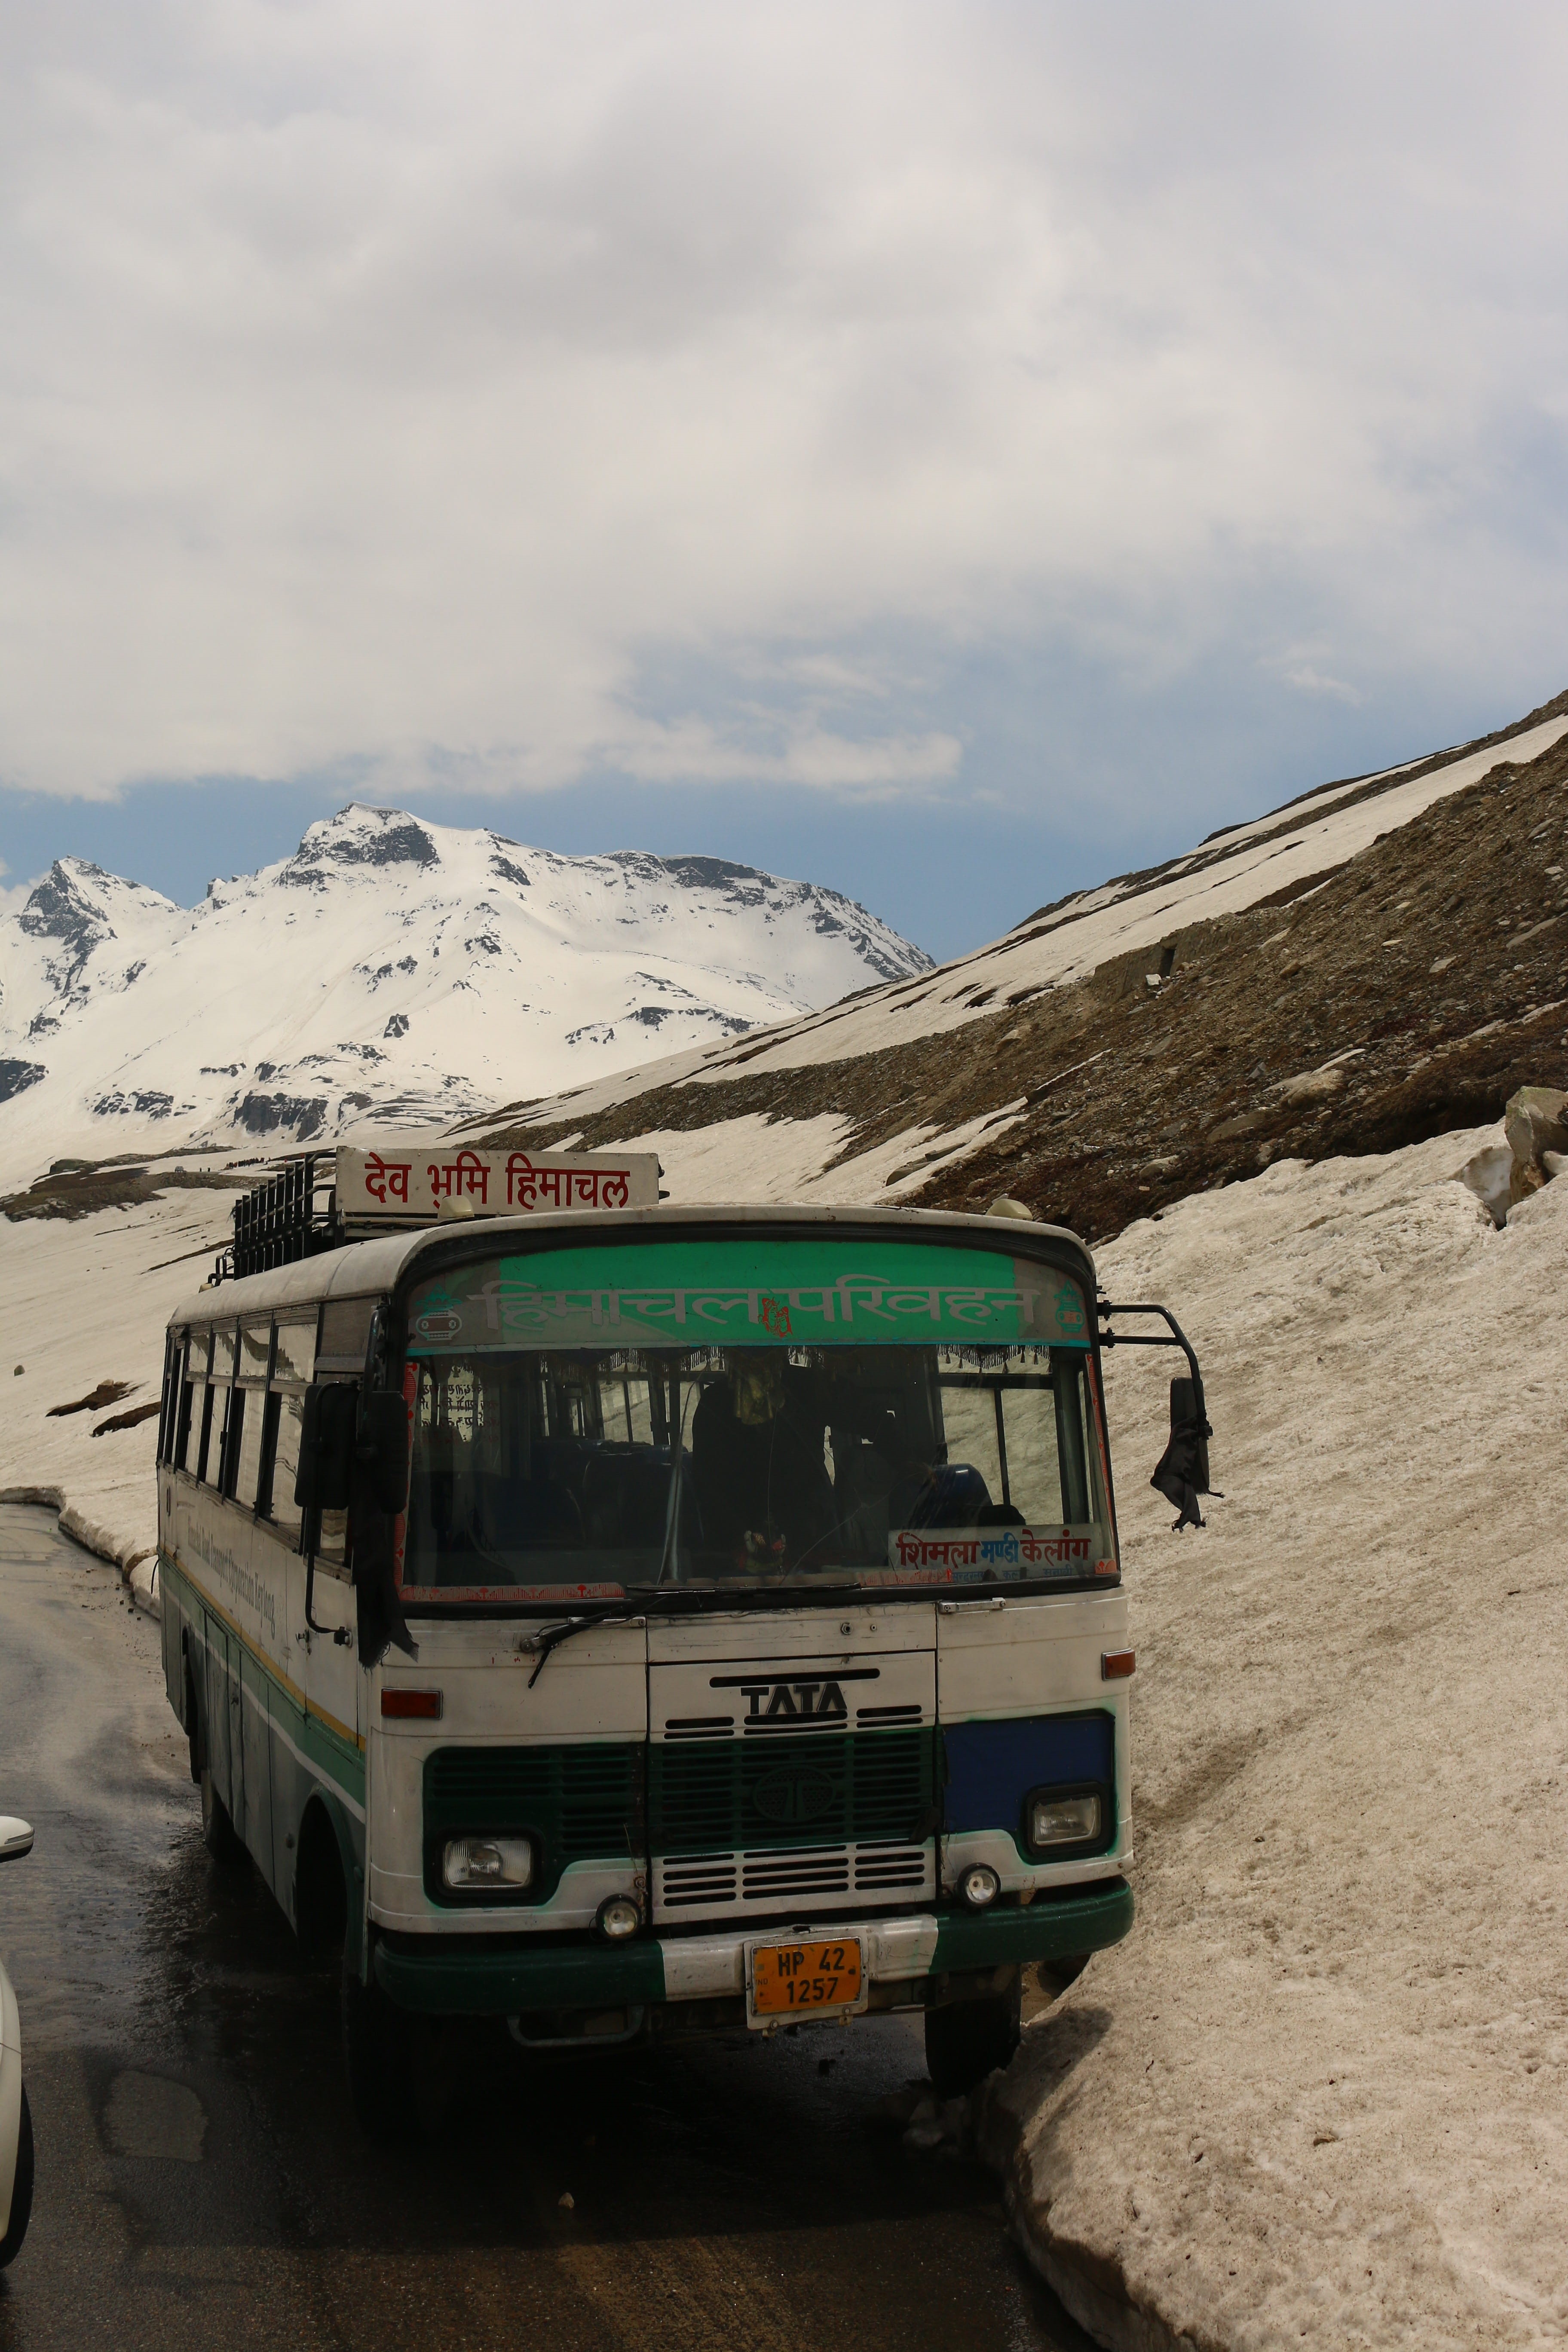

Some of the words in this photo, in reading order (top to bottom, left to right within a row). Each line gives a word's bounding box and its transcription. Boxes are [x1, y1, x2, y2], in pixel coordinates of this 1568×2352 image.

[364, 1152, 412, 1204] देव
[505, 1152, 631, 1210] हिमाचल
[466, 1279, 770, 1331] हिमाचल
[771, 1274, 1041, 1325] परिवहन
[895, 1532, 981, 1570] शिमला
[980, 1532, 1019, 1564] मण्डी
[1019, 1528, 1092, 1566] केलांग
[741, 1682, 848, 1715] TATA
[778, 1951, 804, 1976] HP
[819, 1947, 845, 1972] 42
[787, 1977, 839, 2004] 1257
